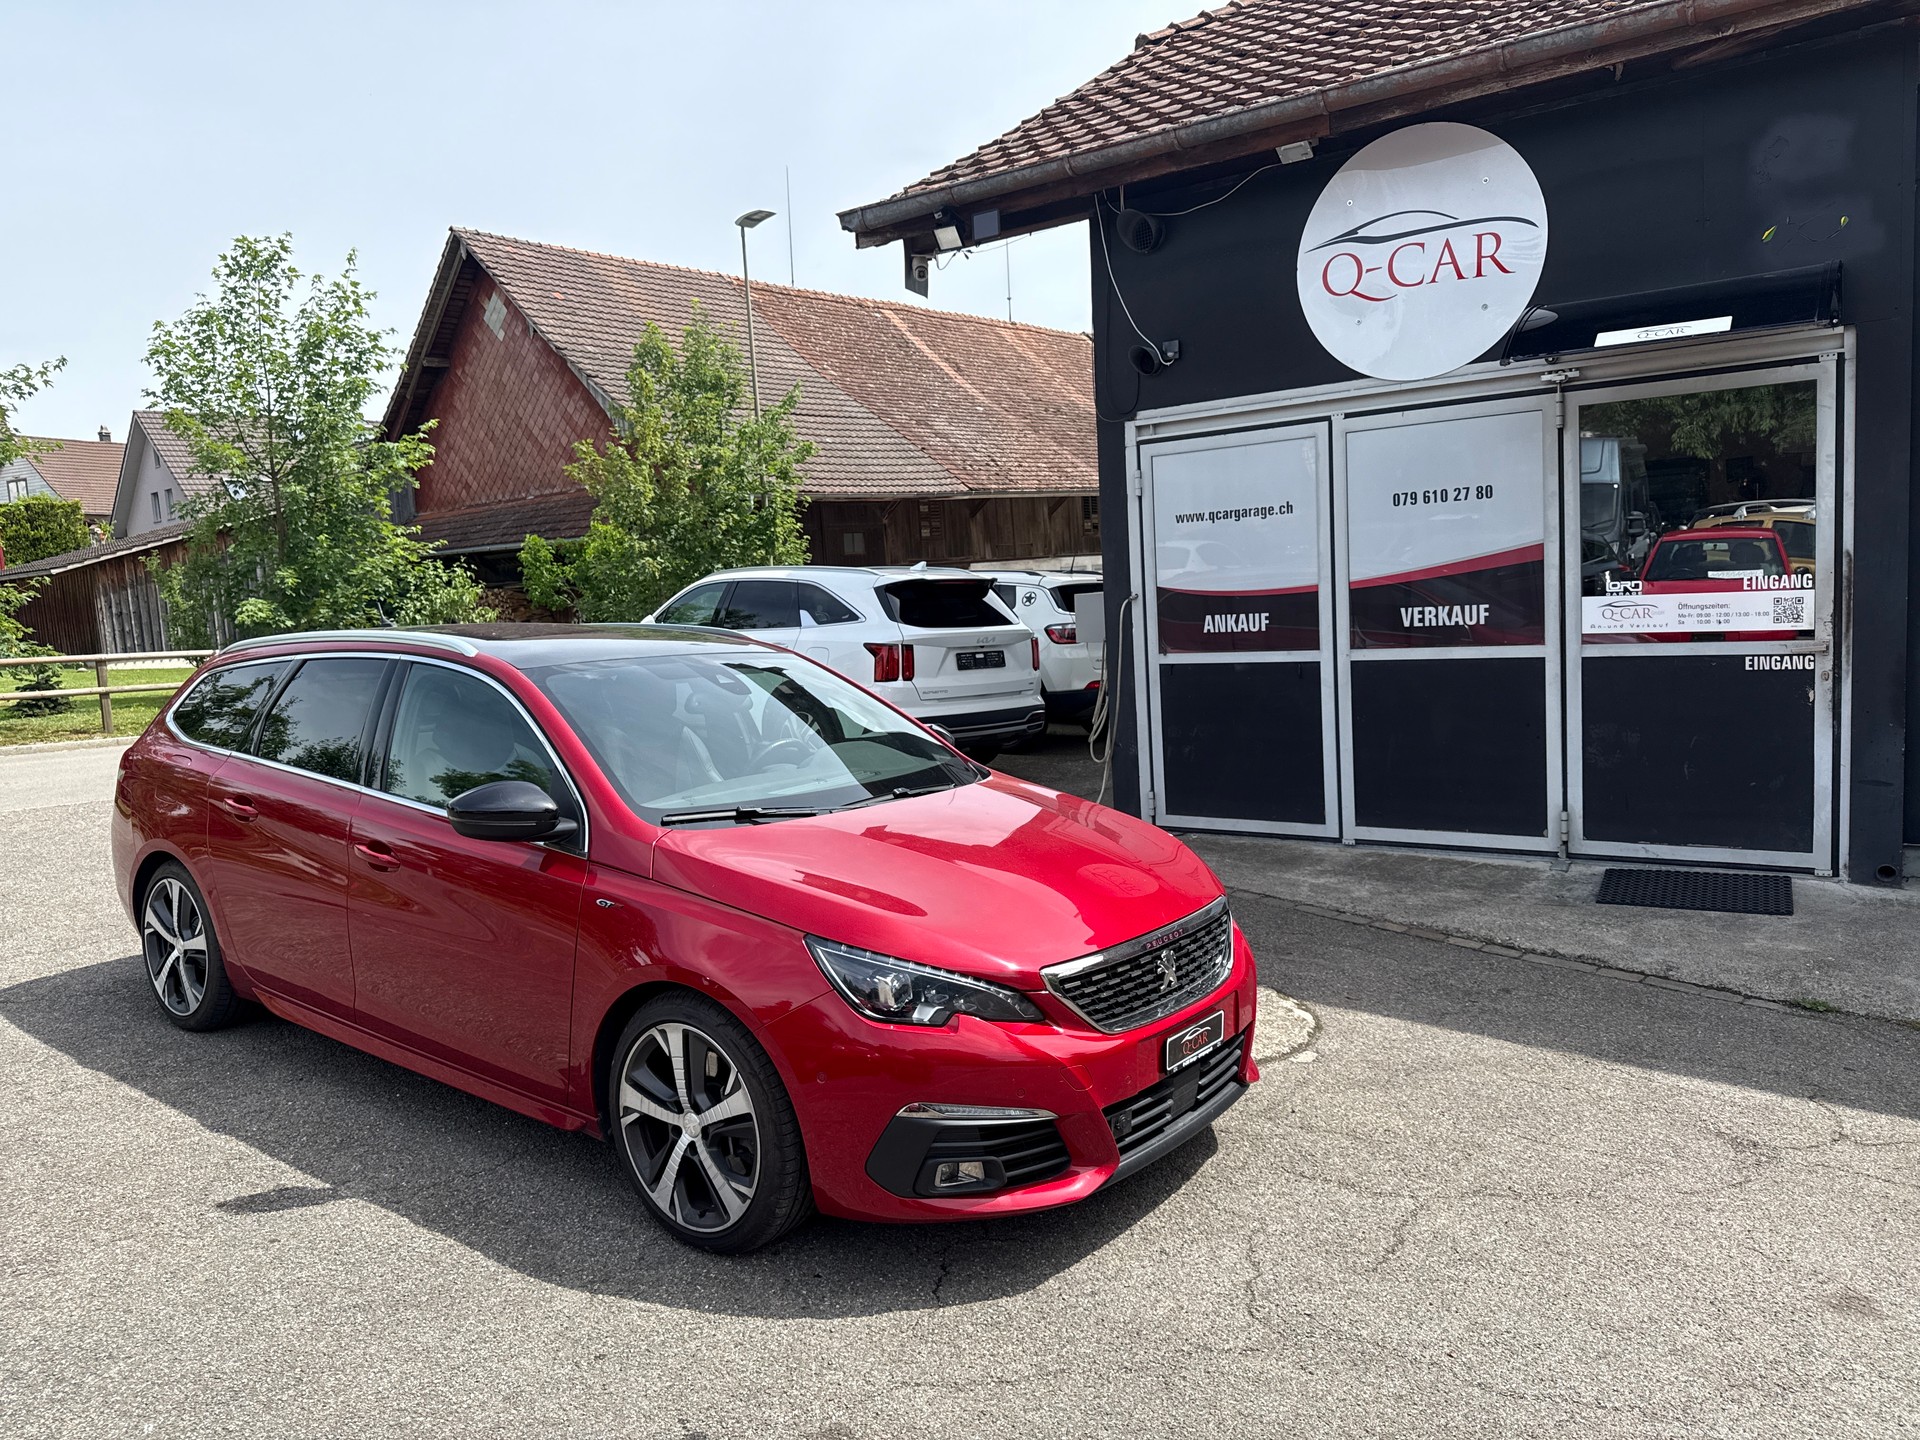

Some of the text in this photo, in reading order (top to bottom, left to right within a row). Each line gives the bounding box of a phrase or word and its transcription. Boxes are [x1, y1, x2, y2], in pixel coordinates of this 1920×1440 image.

[1321, 231, 1517, 302] Q-CAR
[1637, 327, 1686, 339] Q-CAR
[1392, 484, 1494, 507] 079 610 27 80
[1175, 501, 1294, 524] www.qcargarage.ch
[1743, 573, 1813, 591] EINGANG
[1400, 604, 1490, 628] VERKAUF
[1601, 607, 1653, 622] Q-CAR
[1677, 602, 1731, 611] Öffnungszeiten:
[1203, 613, 1270, 633] ANKAUF
[1744, 655, 1815, 671] EINGANG
[1146, 928, 1184, 949] PEUGEOT
[1182, 1031, 1209, 1055] Q-CAR
